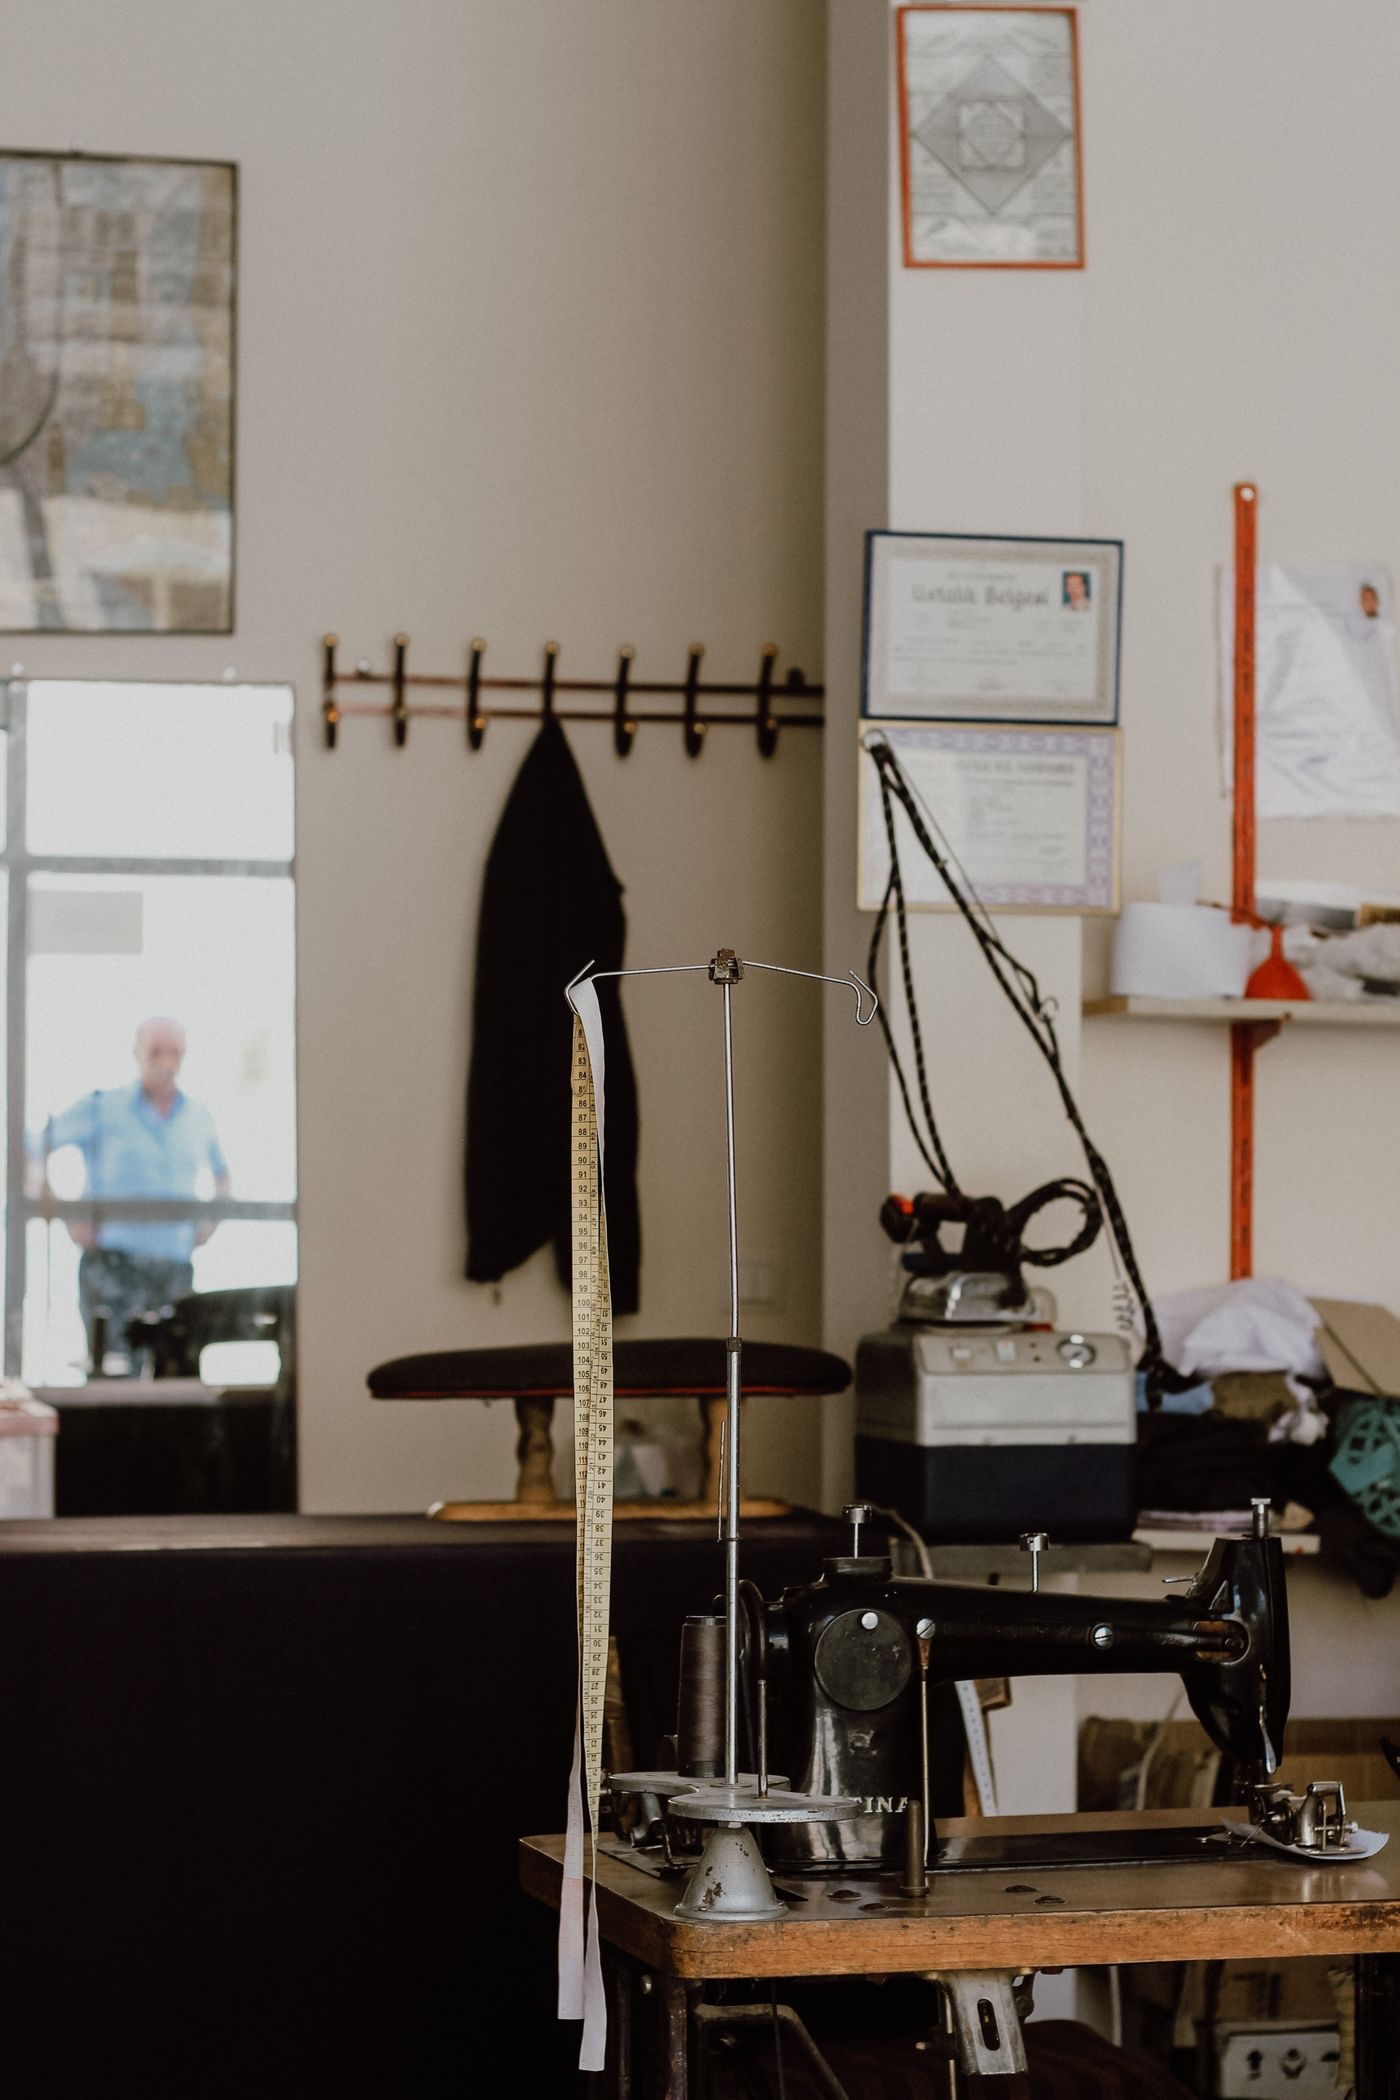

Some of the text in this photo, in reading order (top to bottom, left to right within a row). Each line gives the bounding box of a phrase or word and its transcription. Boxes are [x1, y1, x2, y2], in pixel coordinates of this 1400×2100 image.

[578, 1057, 587, 1065] 83
[578, 1071, 587, 1079] 84
[578, 1099, 587, 1107] 86
[578, 1114, 587, 1122] 87
[578, 1128, 587, 1136] 88
[578, 1142, 587, 1150] 89
[578, 1156, 587, 1164] 90
[578, 1199, 588, 1207] 93
[578, 1213, 588, 1221] 94
[578, 1227, 588, 1235] 95
[578, 1256, 588, 1264] 97
[578, 1270, 588, 1278] 98
[577, 1299, 591, 1307] 100
[577, 1313, 590, 1321] 101
[577, 1327, 590, 1335] 102
[601, 1324, 608, 1332] 52
[577, 1342, 590, 1350] 103
[601, 1338, 608, 1346] 51
[578, 1356, 590, 1364] 104
[601, 1353, 608, 1361] 50
[578, 1370, 590, 1378] 105
[600, 1367, 608, 1375] 49
[578, 1384, 590, 1392] 106
[599, 1381, 608, 1389] 48
[579, 1399, 590, 1407] 107
[579, 1413, 590, 1421] 108
[598, 1410, 607, 1418] 46
[578, 1427, 589, 1435] 109
[598, 1424, 607, 1432] 45
[578, 1441, 588, 1449] 110
[598, 1439, 607, 1447] 44
[597, 1453, 607, 1461] 43
[597, 1467, 607, 1475] 42
[597, 1481, 606, 1489] 41
[596, 1496, 606, 1504] 40
[595, 1510, 605, 1518] 39
[595, 1524, 605, 1532] 38
[594, 1553, 604, 1561] 36
[593, 1582, 603, 1590] 34
[593, 1596, 603, 1604] 33
[593, 1625, 603, 1633] 31
[593, 1639, 602, 1647] 30
[592, 1654, 601, 1662] 29
[591, 1668, 600, 1676] 28
[591, 1682, 599, 1690] 27
[590, 1697, 599, 1705] 26
[590, 1711, 598, 1719] 25
